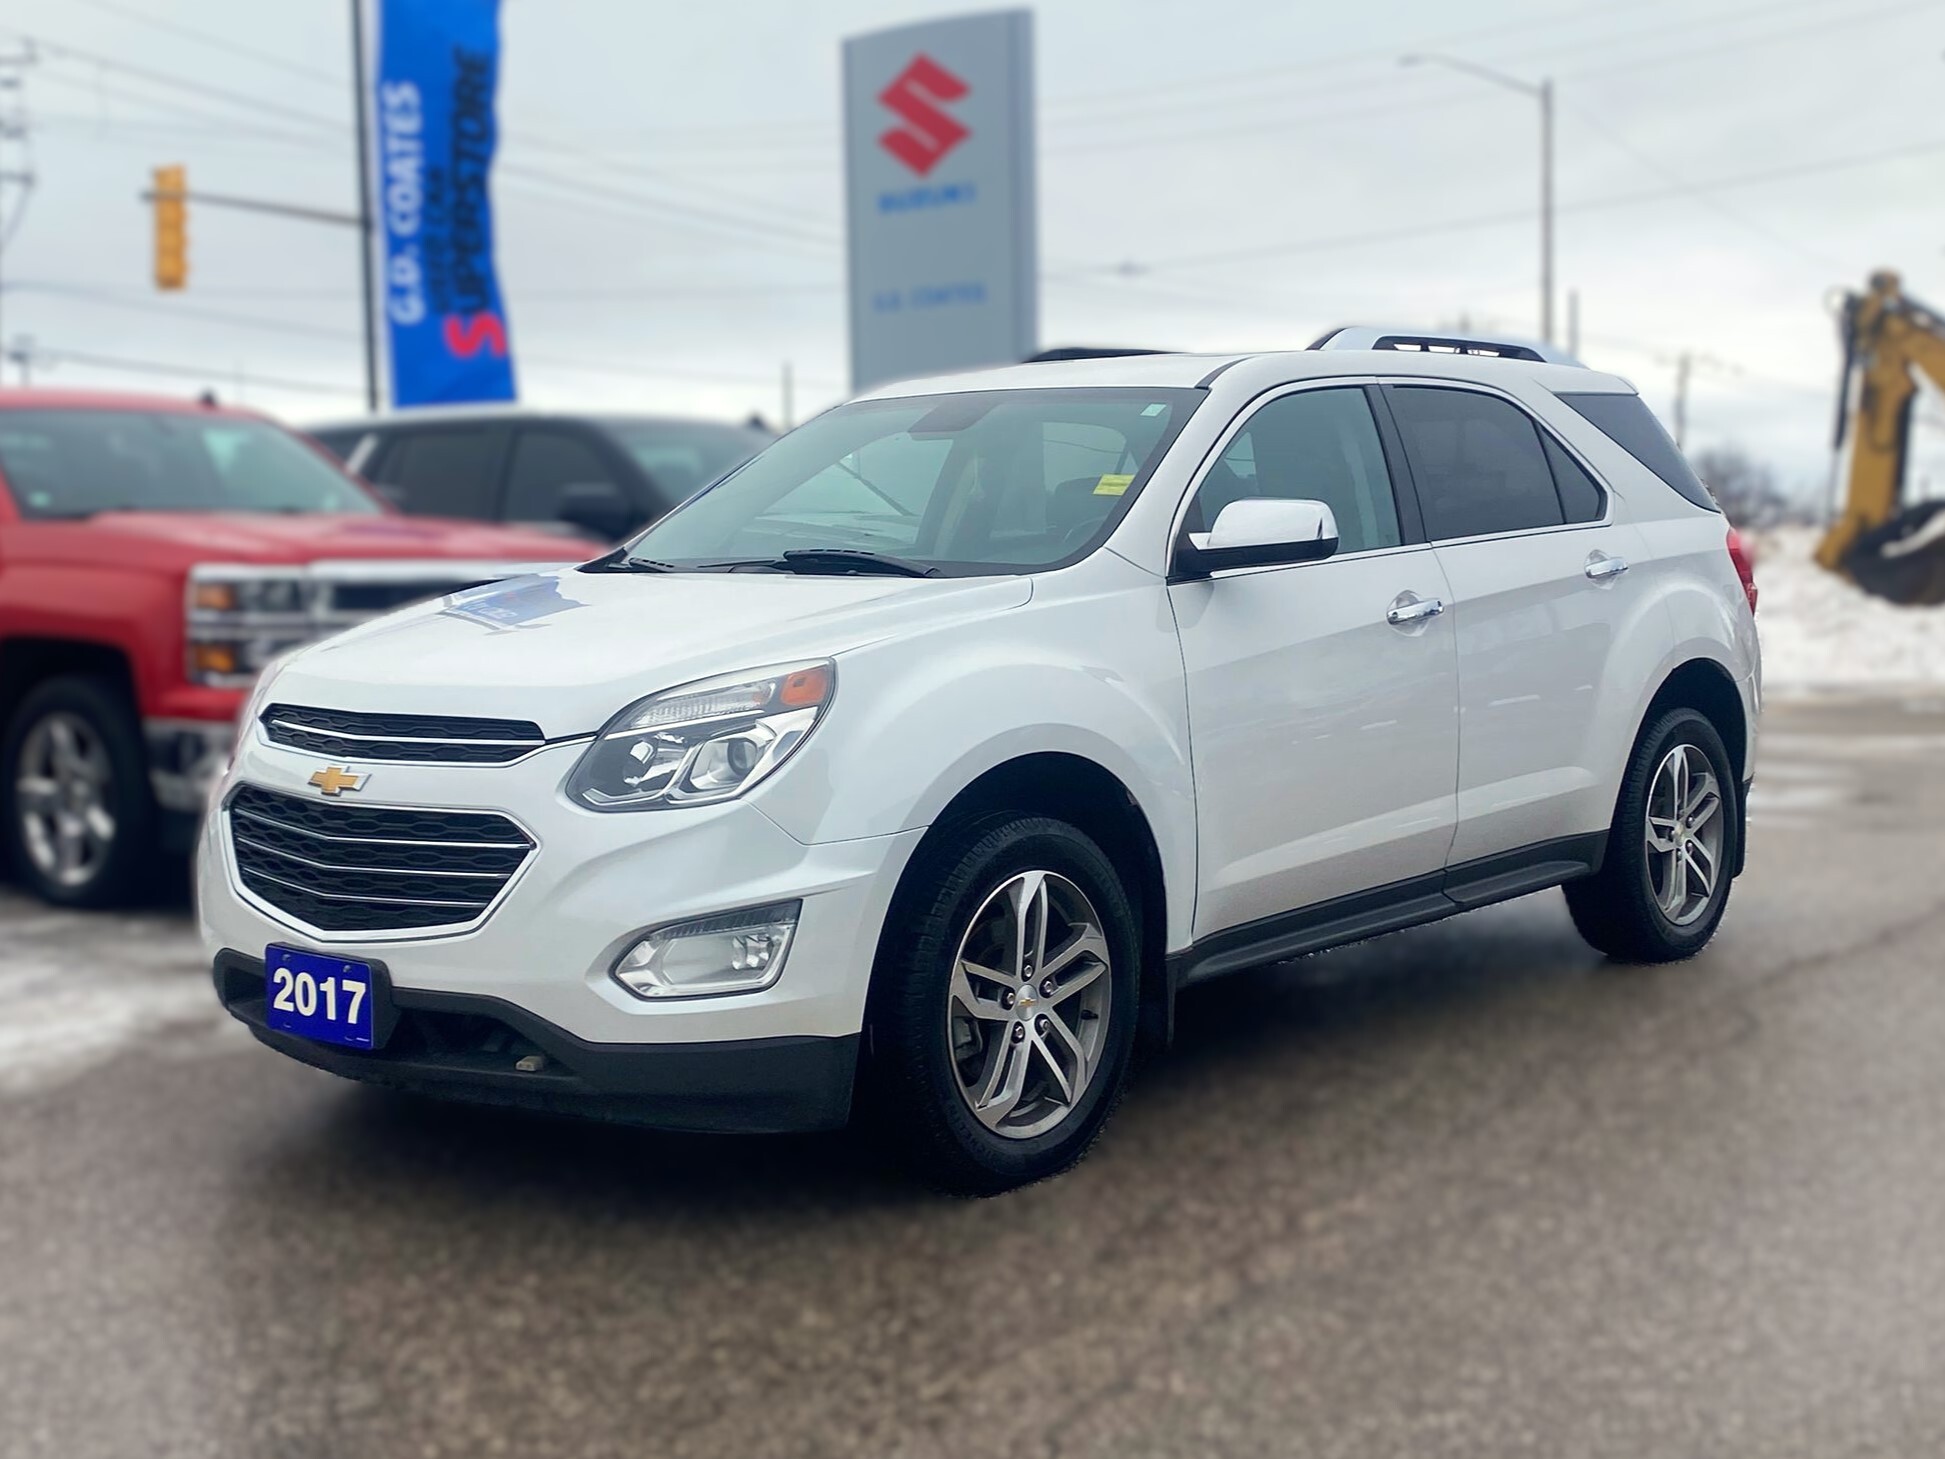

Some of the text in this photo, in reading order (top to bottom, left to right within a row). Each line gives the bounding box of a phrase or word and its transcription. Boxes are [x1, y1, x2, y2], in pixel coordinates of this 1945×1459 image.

[382, 80, 425, 236] COATES
[443, 44, 509, 356] SUPERSTORE
[274, 967, 366, 1025] 2017
